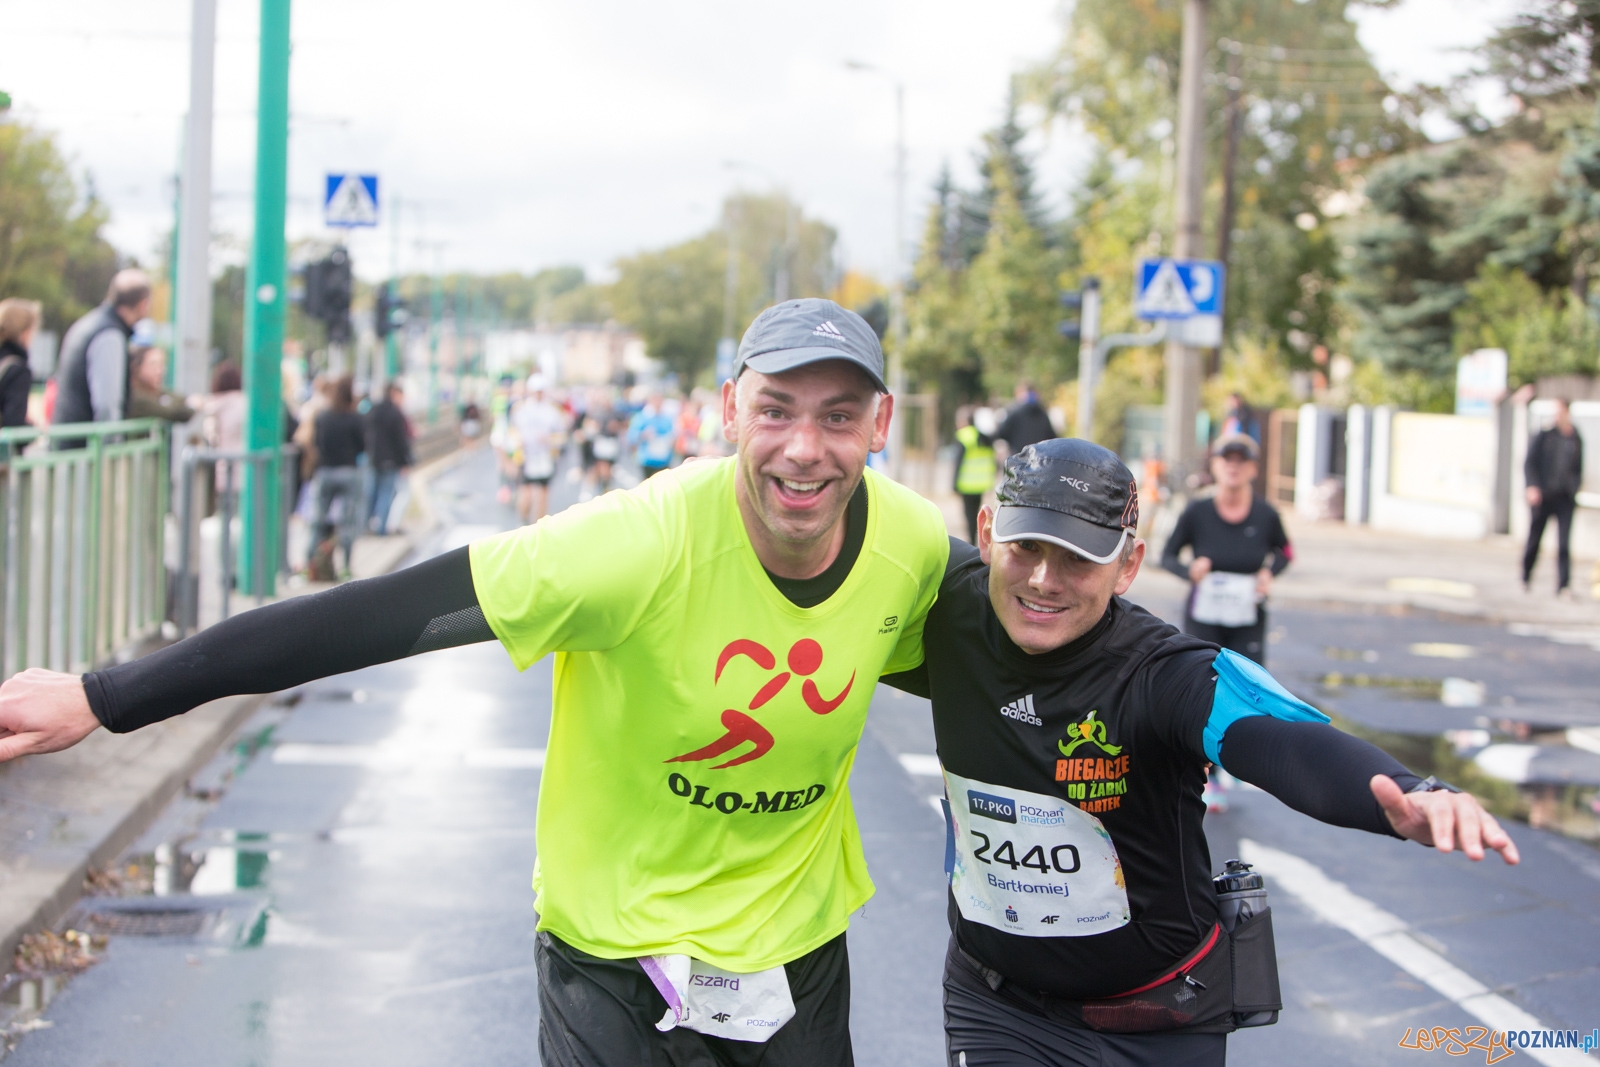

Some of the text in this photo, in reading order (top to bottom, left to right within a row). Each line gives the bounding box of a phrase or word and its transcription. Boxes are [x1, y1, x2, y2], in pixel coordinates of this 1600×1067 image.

[1000, 706, 1043, 727] adidas
[1055, 755, 1130, 781] BIEGACZE
[668, 772, 826, 814] OLO-MED
[1068, 777, 1127, 800] DO ŻABKI
[1080, 796, 1121, 813] BARTEK
[1021, 815, 1065, 825] maraton
[970, 830, 1081, 874] 2440
[987, 873, 1069, 897] Bartłomiej
[1041, 915, 1060, 924] 4F
[711, 1012, 731, 1023] 4F
